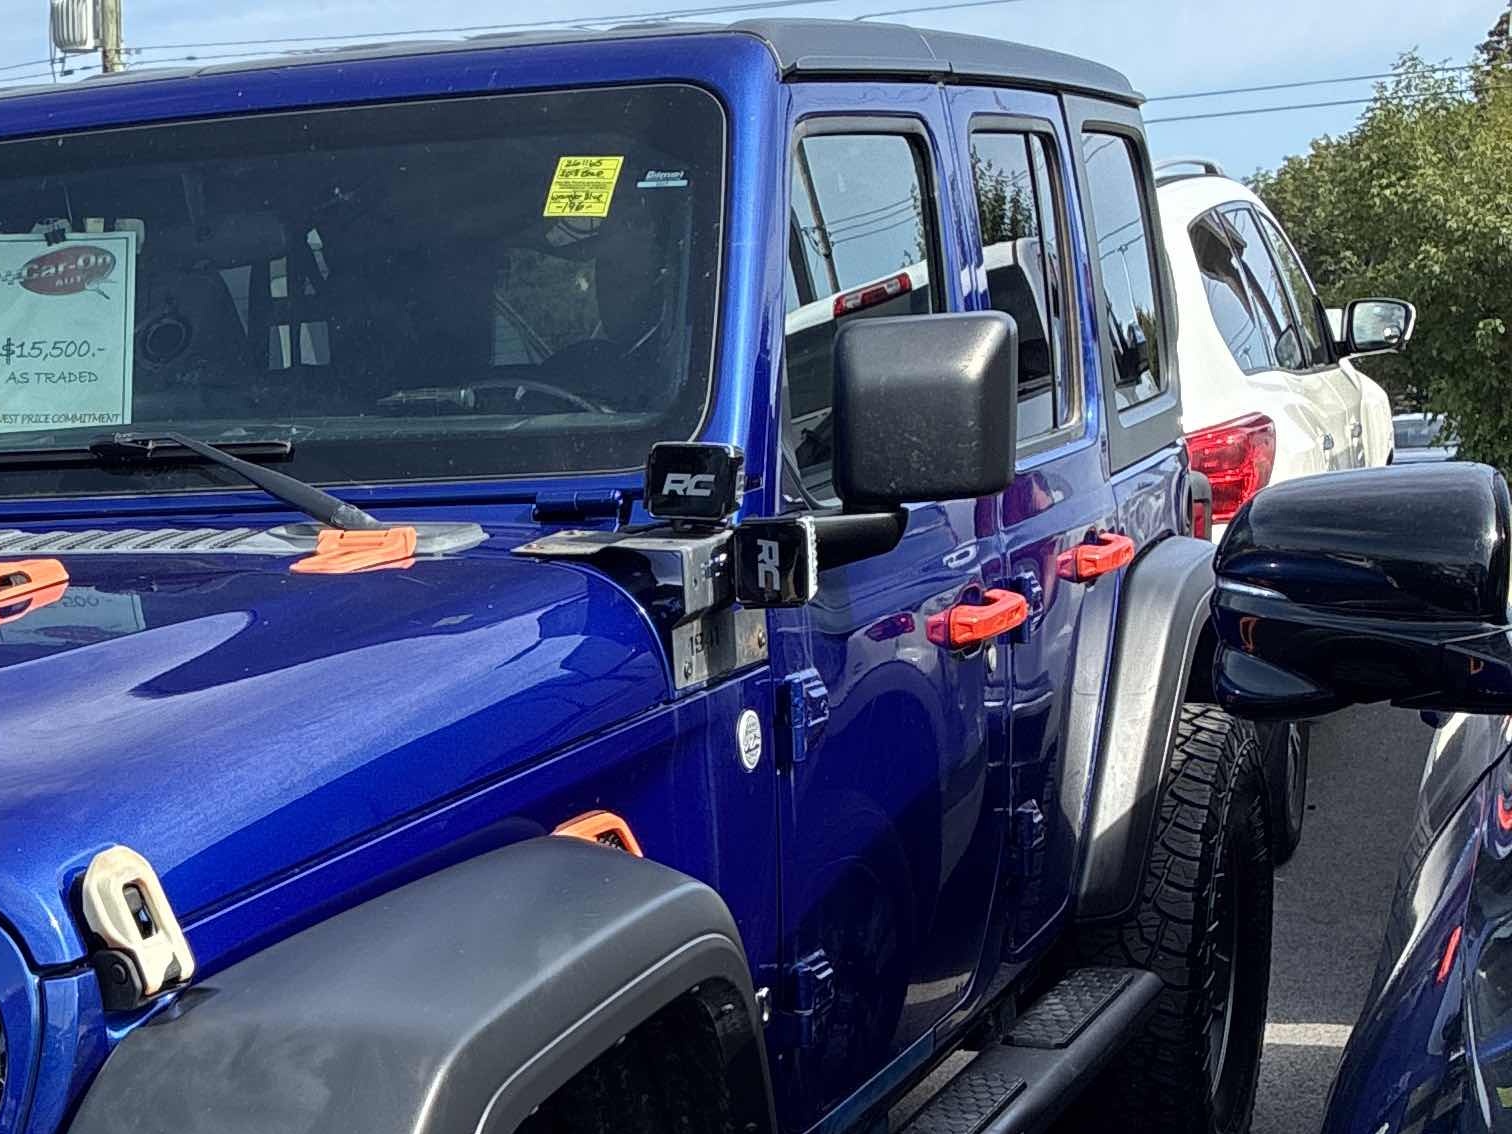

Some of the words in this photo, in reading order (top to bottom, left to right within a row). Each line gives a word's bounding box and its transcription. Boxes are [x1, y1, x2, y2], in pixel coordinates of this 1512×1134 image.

[22, 253, 112, 280] Car-On
[5, 371, 30, 384] AS
[36, 370, 99, 384] TRADED
[21, 413, 52, 424] PRICE
[52, 412, 121, 424] COMMITMENT
[662, 473, 716, 497] RC
[756, 538, 781, 592] RC
